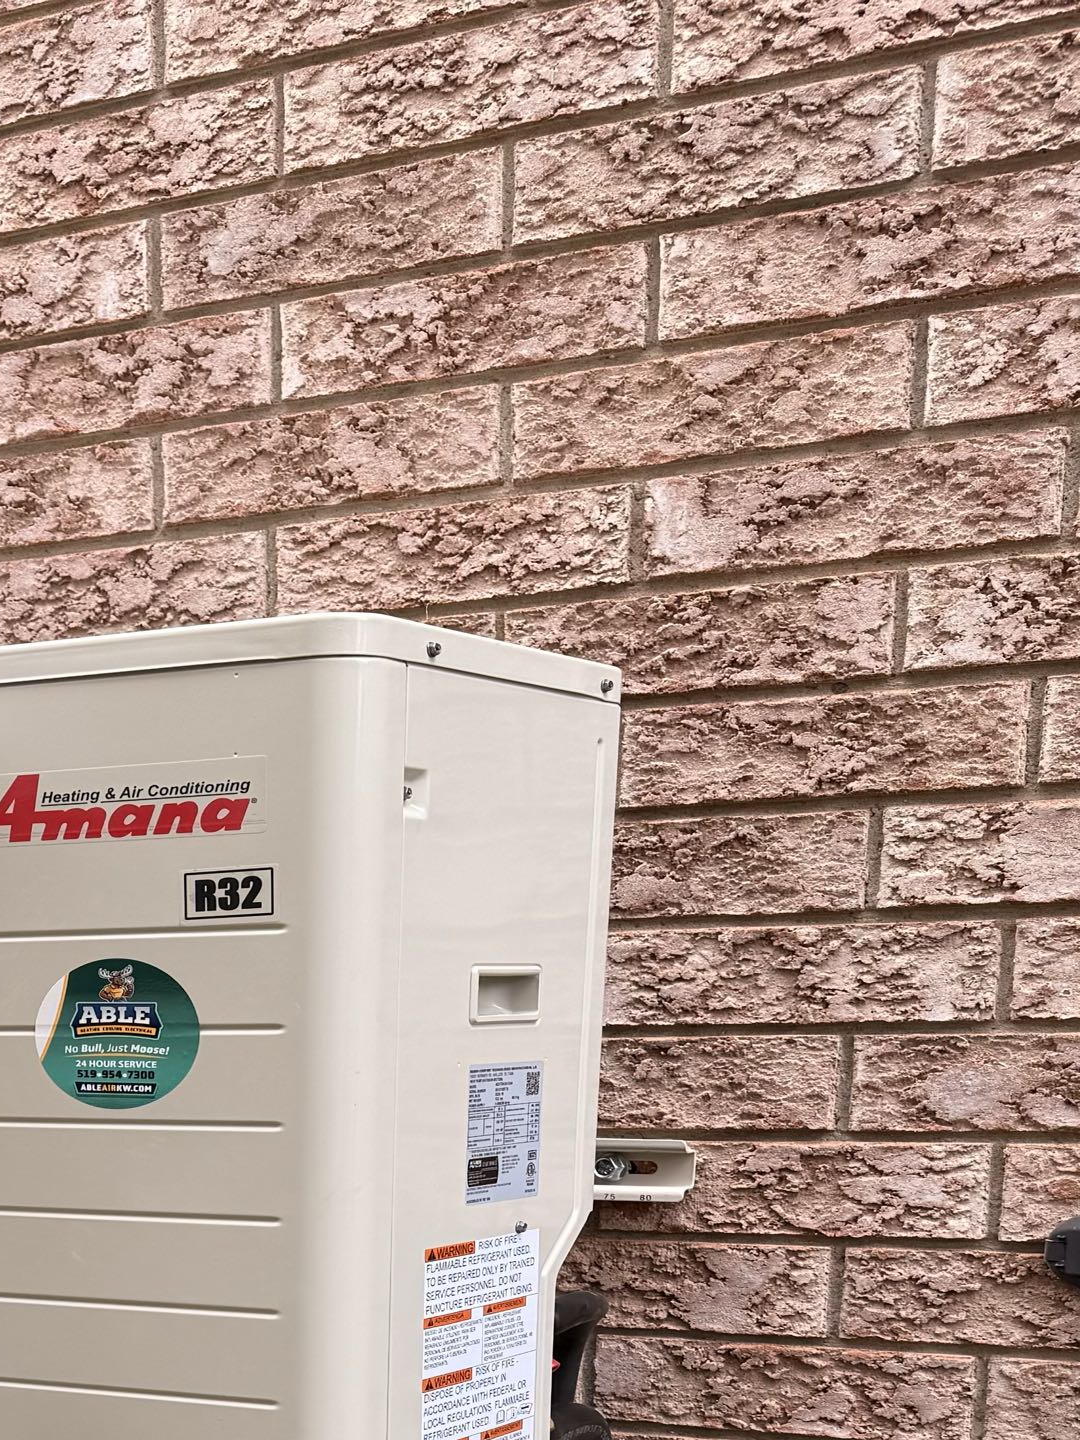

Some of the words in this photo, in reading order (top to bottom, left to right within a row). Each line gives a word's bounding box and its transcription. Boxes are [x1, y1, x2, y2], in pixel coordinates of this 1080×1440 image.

[41, 788, 100, 804] Heating
[105, 787, 116, 799] &
[119, 785, 144, 799] Air
[147, 779, 251, 797] Conditioning
[194, 875, 263, 912] R32
[79, 1006, 150, 1025] ABLE
[64, 1045, 79, 1054] No
[81, 1043, 105, 1054] Bull,
[106, 1043, 129, 1053] Just
[130, 1044, 171, 1056] Moose!
[88, 1060, 116, 1068] HOUR
[118, 1060, 158, 1069] SERVICE
[80, 1083, 153, 1093] ABLEAIRKW.COM
[426, 1257, 467, 1273] FLAMMABLE
[468, 1248, 513, 1265] REFRIGERANT
[436, 1241, 475, 1259] WARNING
[478, 1238, 494, 1250] RISK
[494, 1236, 504, 1247] OF
[504, 1234, 518, 1245] FIRE
[427, 1277, 436, 1288] TO
[437, 1274, 447, 1286] BE
[448, 1268, 481, 1283] REPAIRED
[481, 1264, 499, 1278] ONLY
[499, 1261, 508, 1273] BY
[509, 1256, 536, 1270] TRAINED
[425, 1298, 463, 1316] PUNCTURE
[464, 1287, 508, 1306] REFRIGERANT
[426, 1286, 456, 1302] SERVICE
[498, 1275, 508, 1286] DO
[508, 1272, 522, 1283] NOT
[433, 1368, 471, 1387] WARNING
[475, 1365, 491, 1377] RISK
[491, 1362, 501, 1373] OF
[501, 1358, 515, 1369] FIRE
[423, 1386, 454, 1404] DISPOSE
[454, 1384, 464, 1396] OF
[465, 1375, 499, 1393] PROPERLY
[500, 1372, 507, 1381] IN
[423, 1395, 470, 1417] ACCORDANCE
[471, 1390, 489, 1403] WITH
[489, 1383, 517, 1399] FEDERAL
[517, 1379, 527, 1391] OR
[423, 1415, 446, 1431] LOCAL
[494, 1390, 531, 1409] FLAMMABLE
